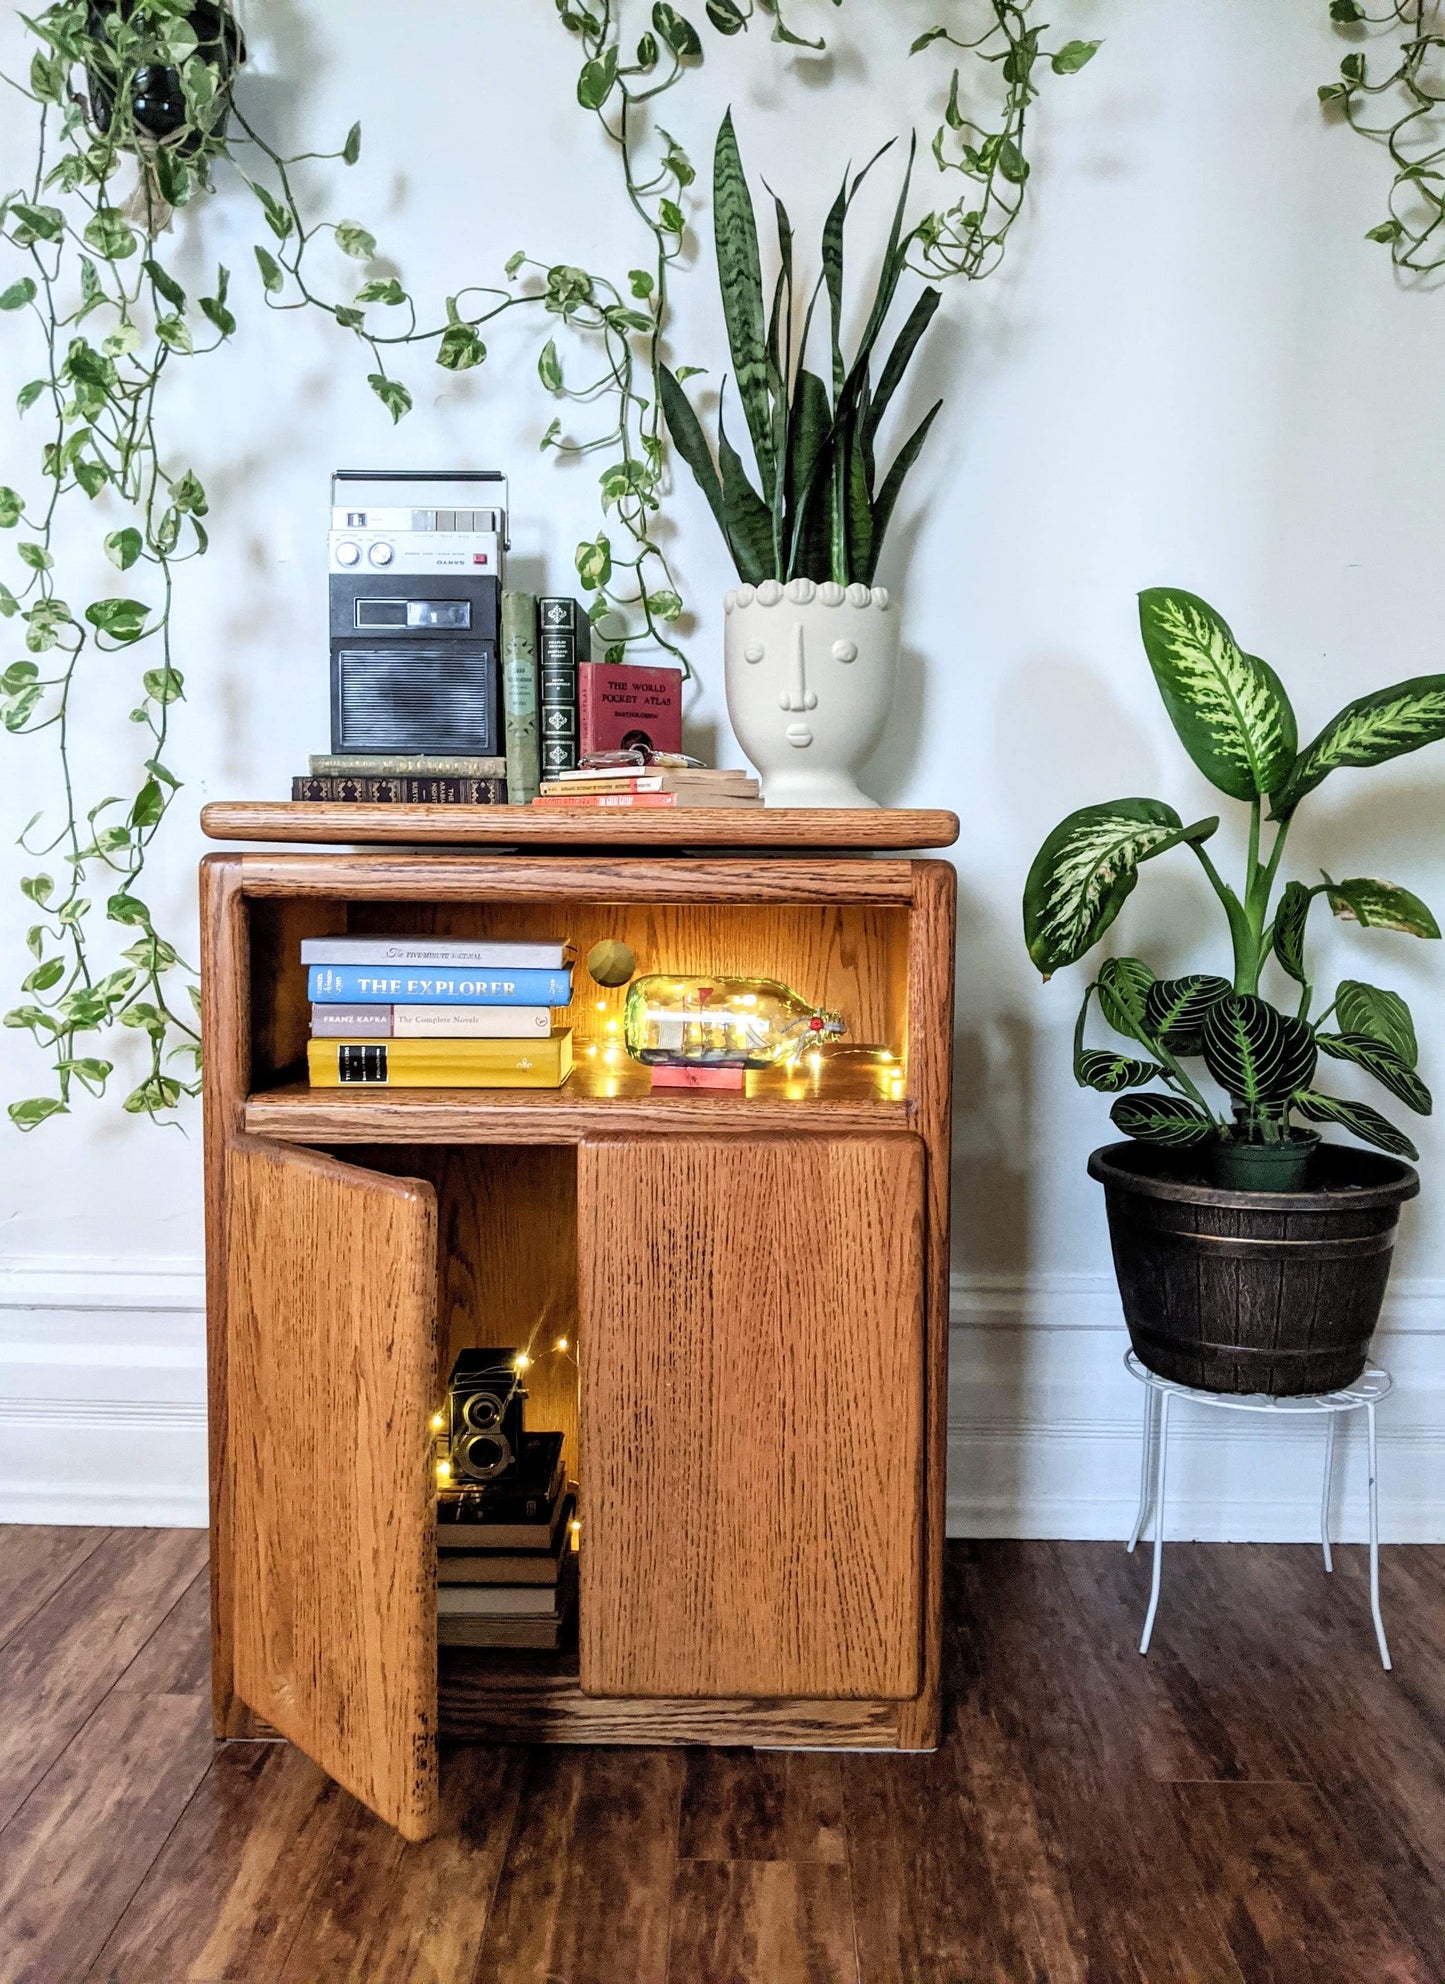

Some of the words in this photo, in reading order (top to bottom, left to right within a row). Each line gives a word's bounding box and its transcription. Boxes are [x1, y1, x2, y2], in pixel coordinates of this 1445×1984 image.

[608, 681, 628, 691] THE
[632, 683, 666, 693] WORLD
[602, 694, 638, 703] POCKET
[644, 697, 671, 705] ATLAS
[357, 978, 401, 995] THE
[406, 979, 517, 998] EXPLORER
[398, 1015, 412, 1023] The
[414, 1015, 451, 1025] Complete
[453, 1015, 479, 1024] Novels
